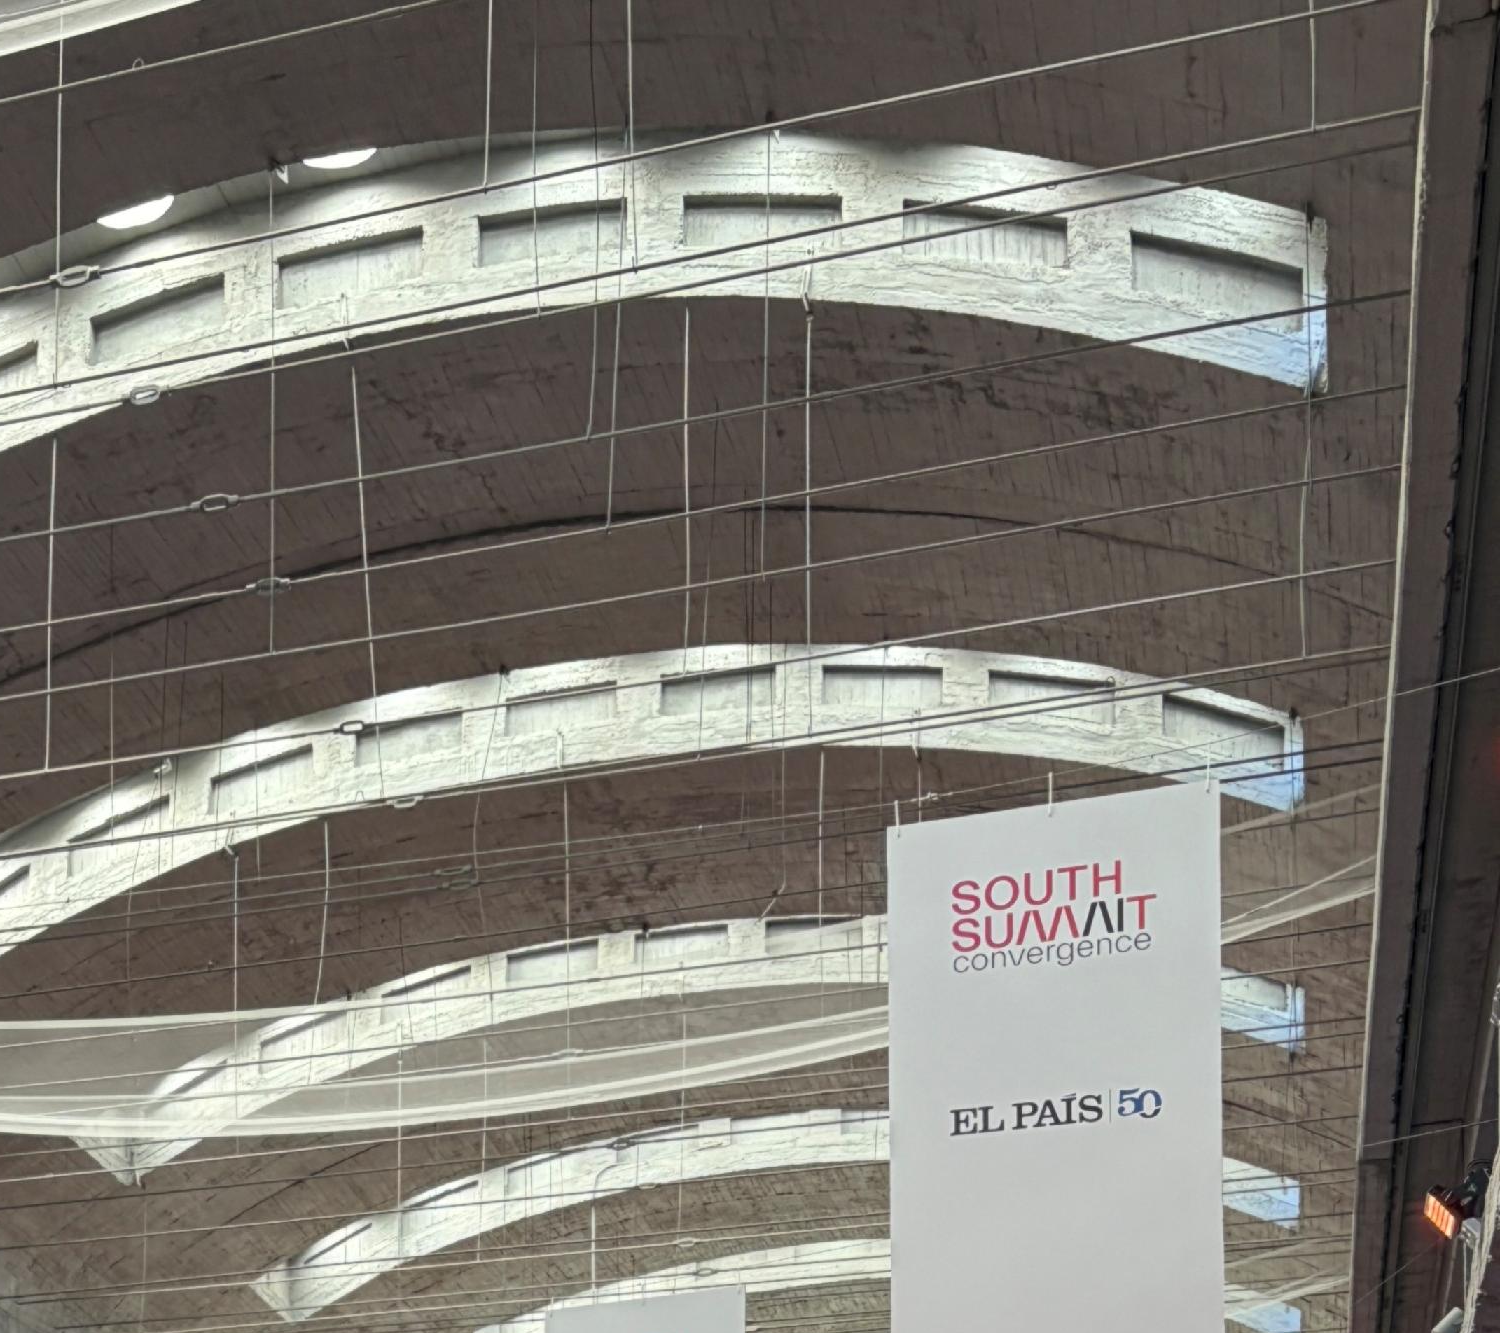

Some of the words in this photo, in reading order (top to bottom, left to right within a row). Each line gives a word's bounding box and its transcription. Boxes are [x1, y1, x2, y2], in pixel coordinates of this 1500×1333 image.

[951, 860, 1122, 915] SOUTH
[951, 893, 1157, 953] SUMMIT
[953, 931, 1152, 973] convergence
[950, 1106, 1005, 1136] EL
[1012, 1092, 1103, 1130] PAÍS
[1117, 1088, 1163, 1118] 50
